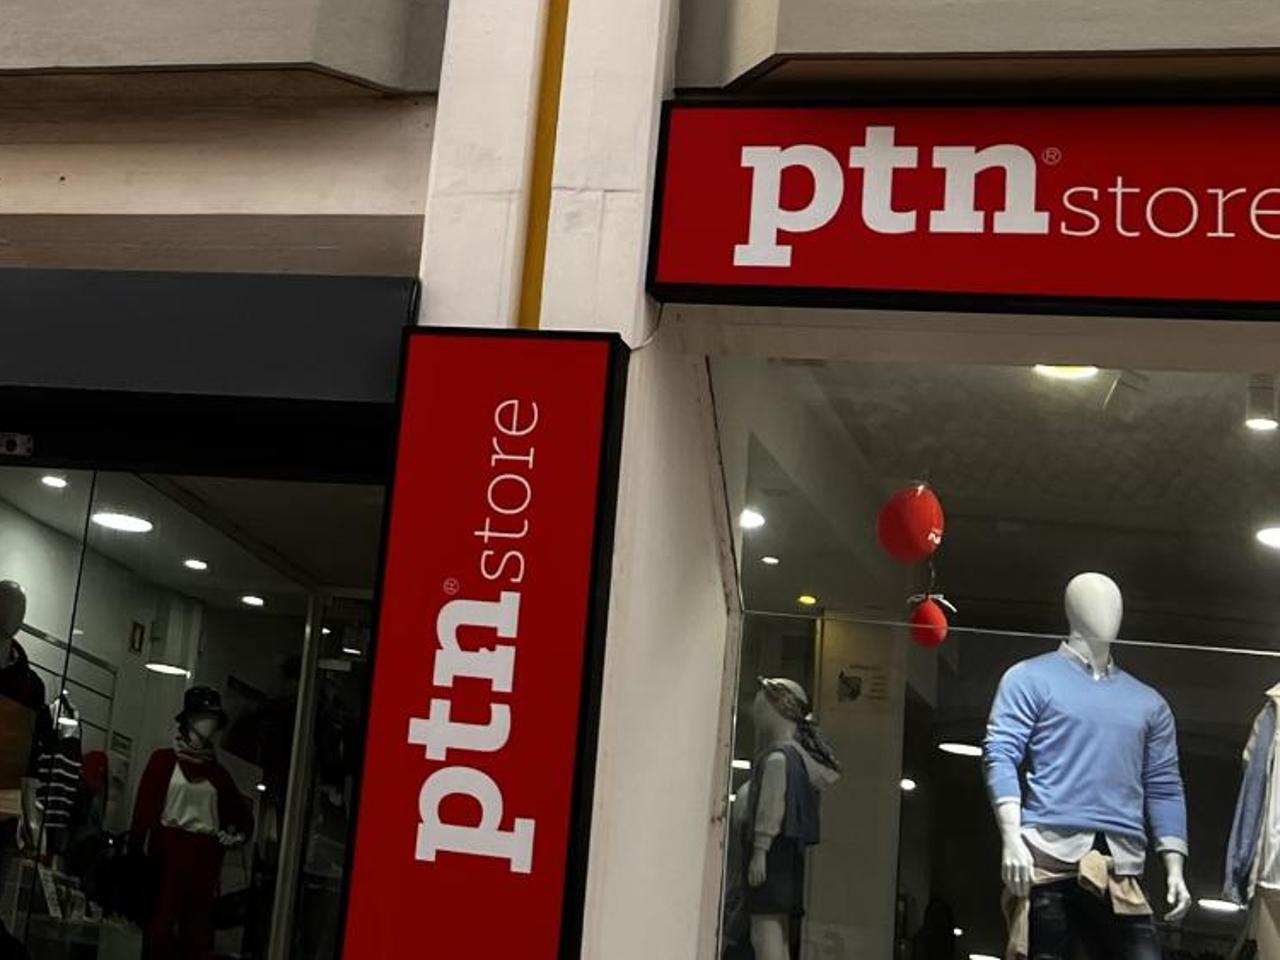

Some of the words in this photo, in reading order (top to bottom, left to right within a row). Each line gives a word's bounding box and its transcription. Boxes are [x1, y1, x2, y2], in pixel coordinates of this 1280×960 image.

[732, 125, 1051, 268] ptn
[407, 590, 536, 875] ptn
[473, 398, 539, 584] store
